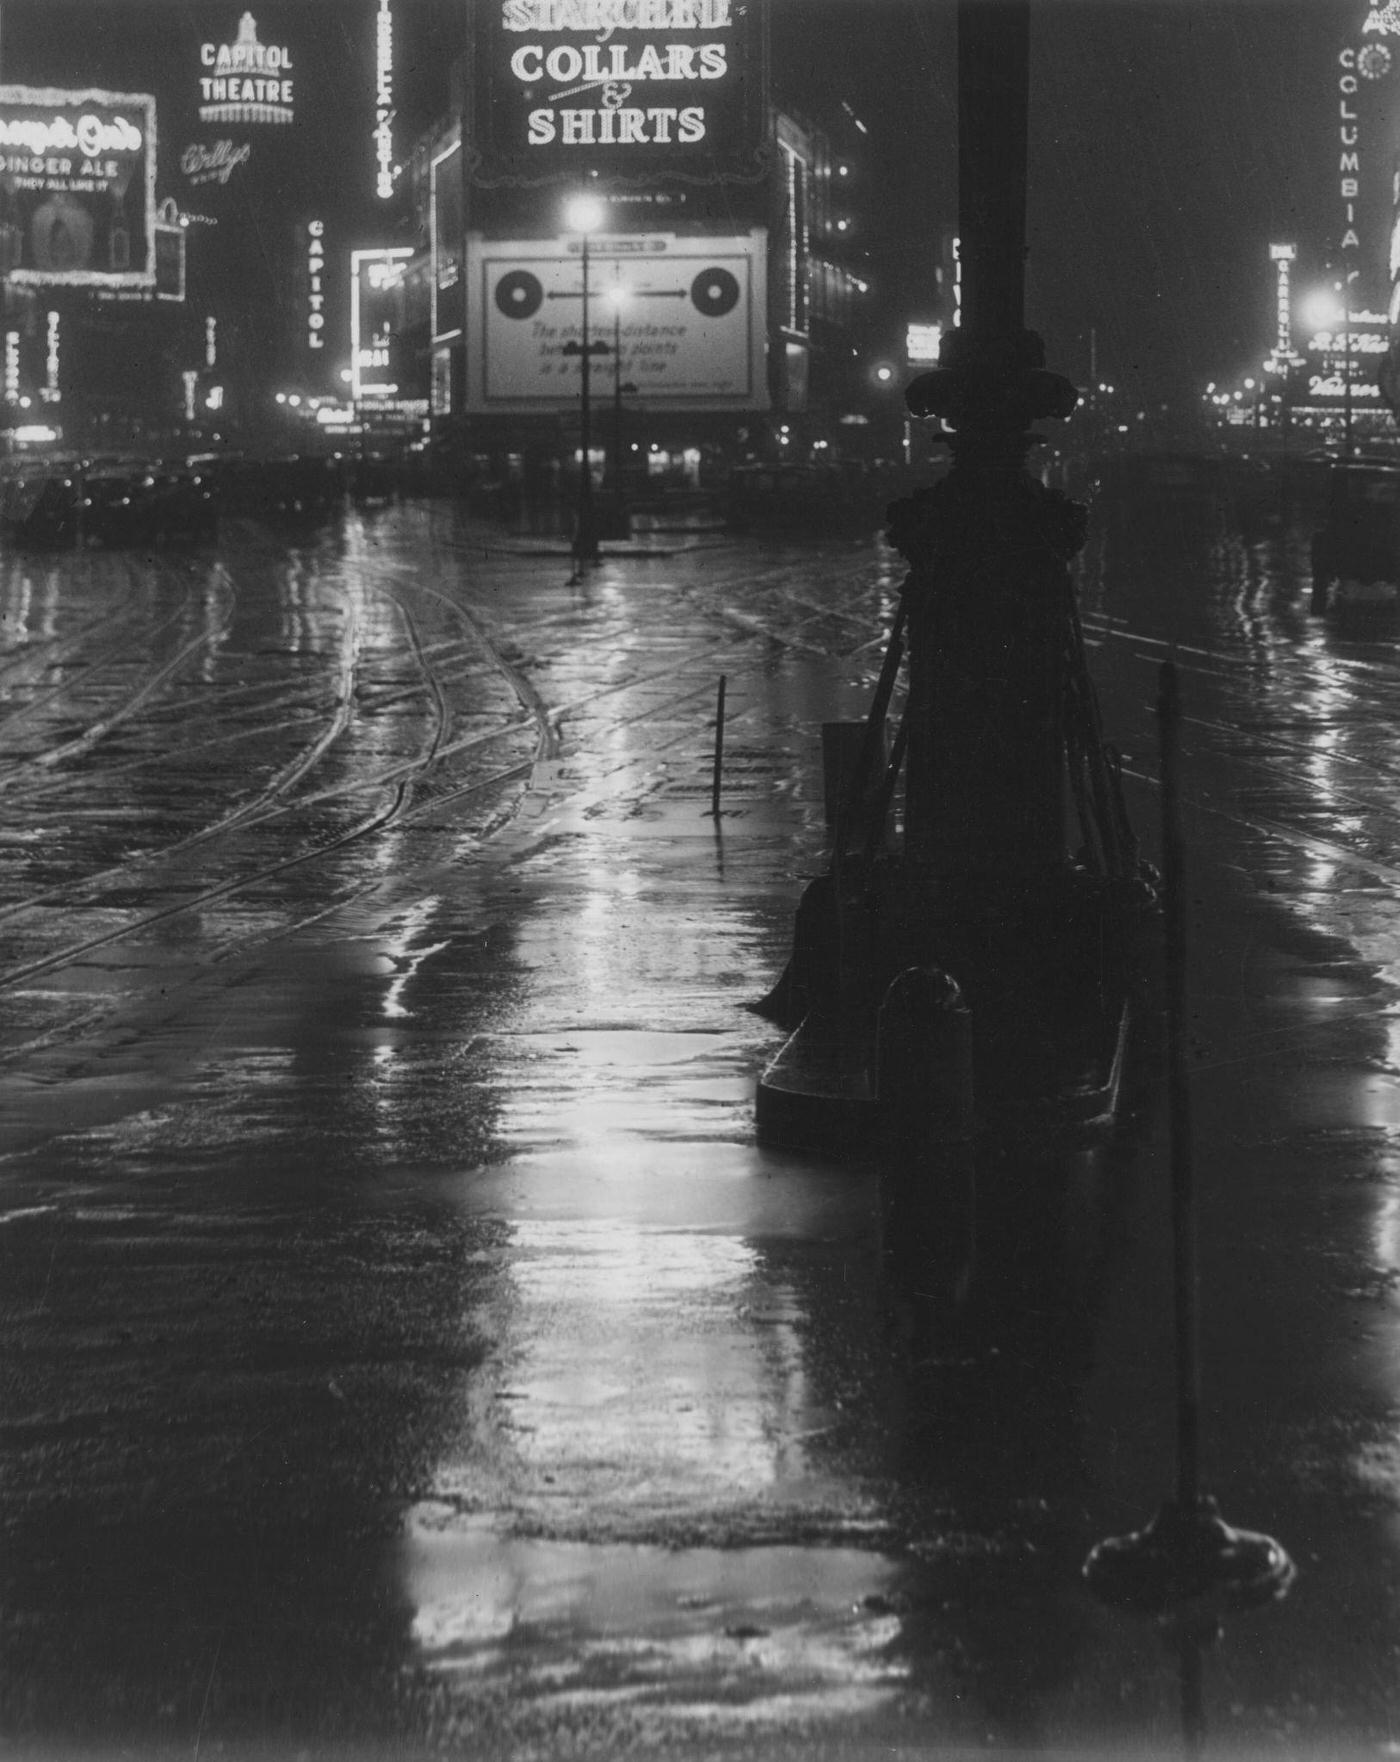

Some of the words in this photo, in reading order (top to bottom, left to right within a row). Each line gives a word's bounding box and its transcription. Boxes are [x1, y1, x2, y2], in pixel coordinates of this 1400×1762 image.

[200, 43, 293, 69] CAPITOL
[510, 44, 728, 81] COLLARS
[200, 77, 294, 102] THEATRE
[601, 81, 632, 110] &
[528, 107, 706, 144] SHIRTS
[1340, 48, 1359, 249] COLUMBIA
[80, 159, 118, 177] ALE
[308, 220, 325, 349] CAPITOL
